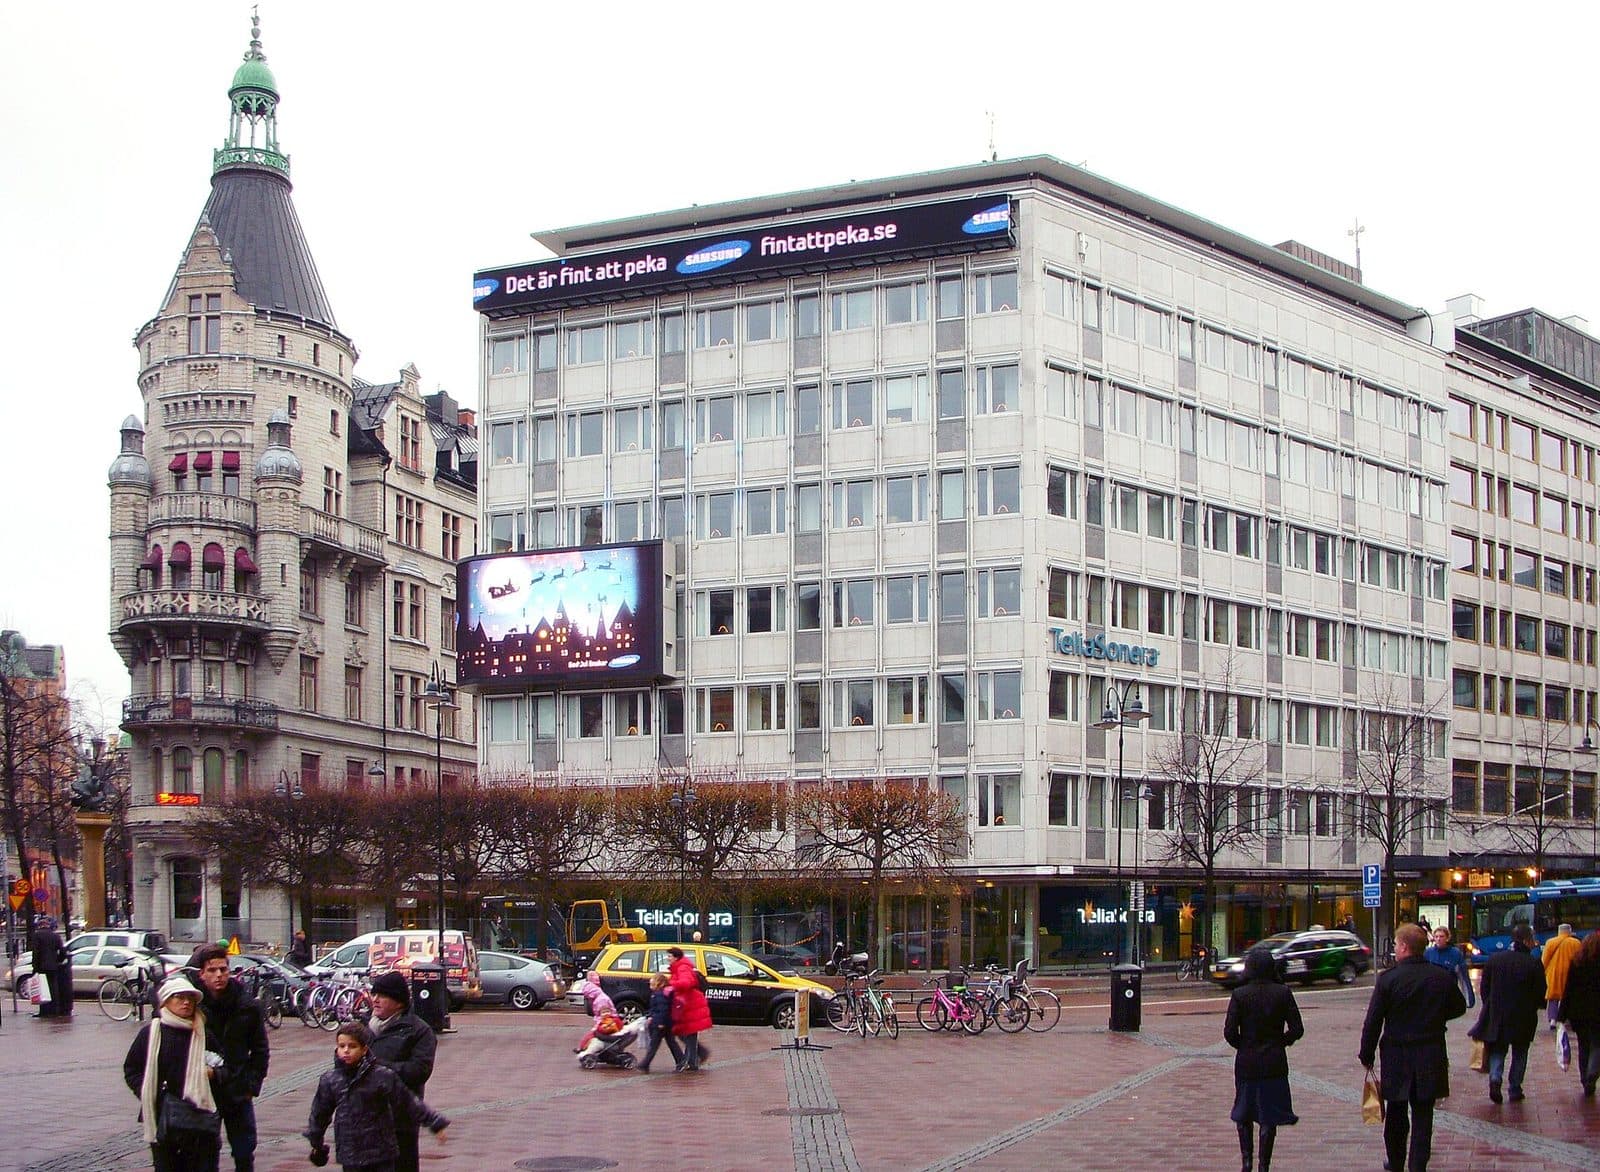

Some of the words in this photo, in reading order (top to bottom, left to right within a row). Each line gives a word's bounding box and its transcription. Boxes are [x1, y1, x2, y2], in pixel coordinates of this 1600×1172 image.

[505, 274, 537, 294] Det
[538, 271, 558, 289] är
[560, 267, 593, 286] fint
[595, 260, 622, 279] att
[624, 254, 667, 282] peka
[685, 247, 742, 265] SAMSUNG
[760, 223, 898, 257] fintattpeka.se
[1049, 627, 1160, 667] TeliaSonera
[1367, 866, 1377, 883] P
